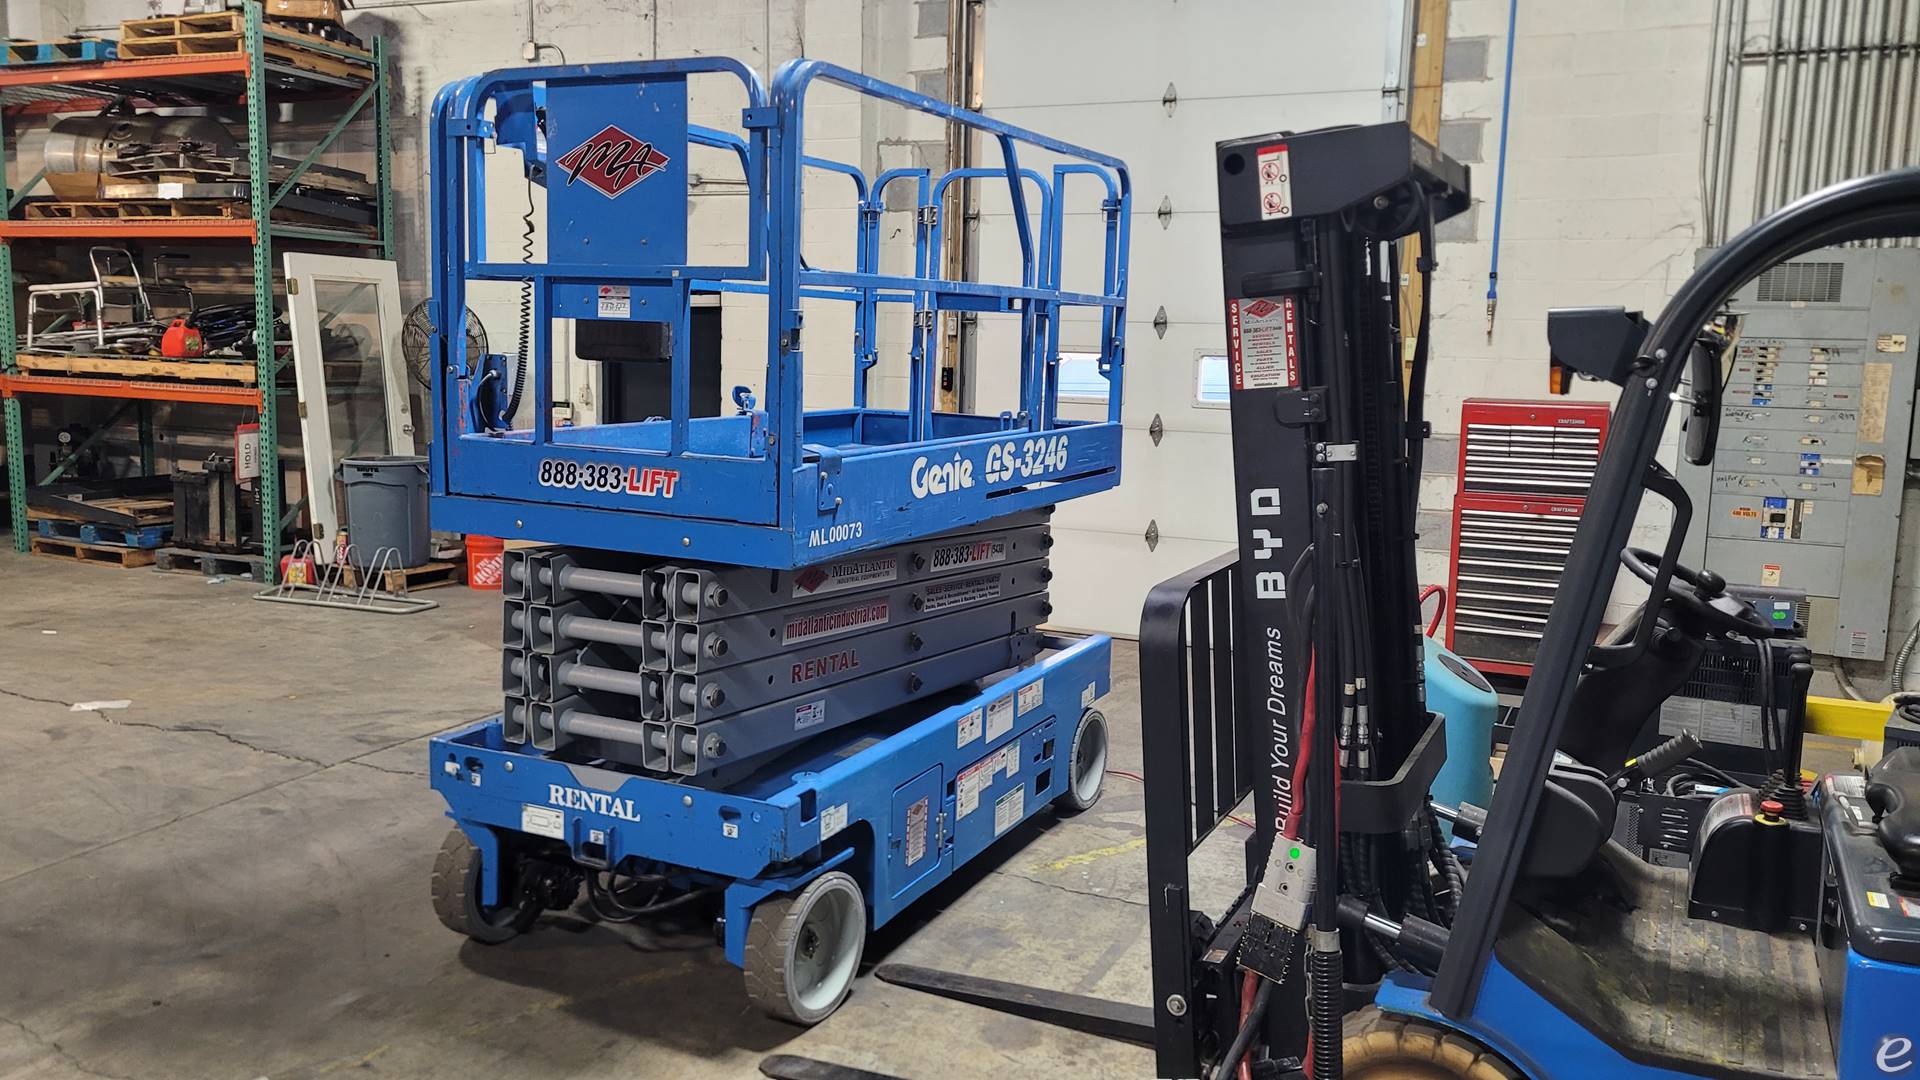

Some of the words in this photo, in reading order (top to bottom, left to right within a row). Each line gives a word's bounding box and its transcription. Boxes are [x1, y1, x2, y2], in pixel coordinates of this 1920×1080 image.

[565, 140, 666, 190] MA
[1231, 303, 1242, 385] SERVICE
[1285, 298, 1296, 382] RENTALS
[244, 442, 252, 470] HOLD
[910, 452, 973, 499] Genie
[985, 434, 1069, 485] GS-3246
[808, 521, 863, 548] ML00073
[1250, 487, 1287, 600] BYD
[786, 603, 888, 640] midatlanticindustrial.com
[791, 649, 860, 684] RENTAL
[1267, 626, 1287, 715] Dreams
[1270, 719, 1290, 769] Your
[548, 784, 641, 822] RENTAL
